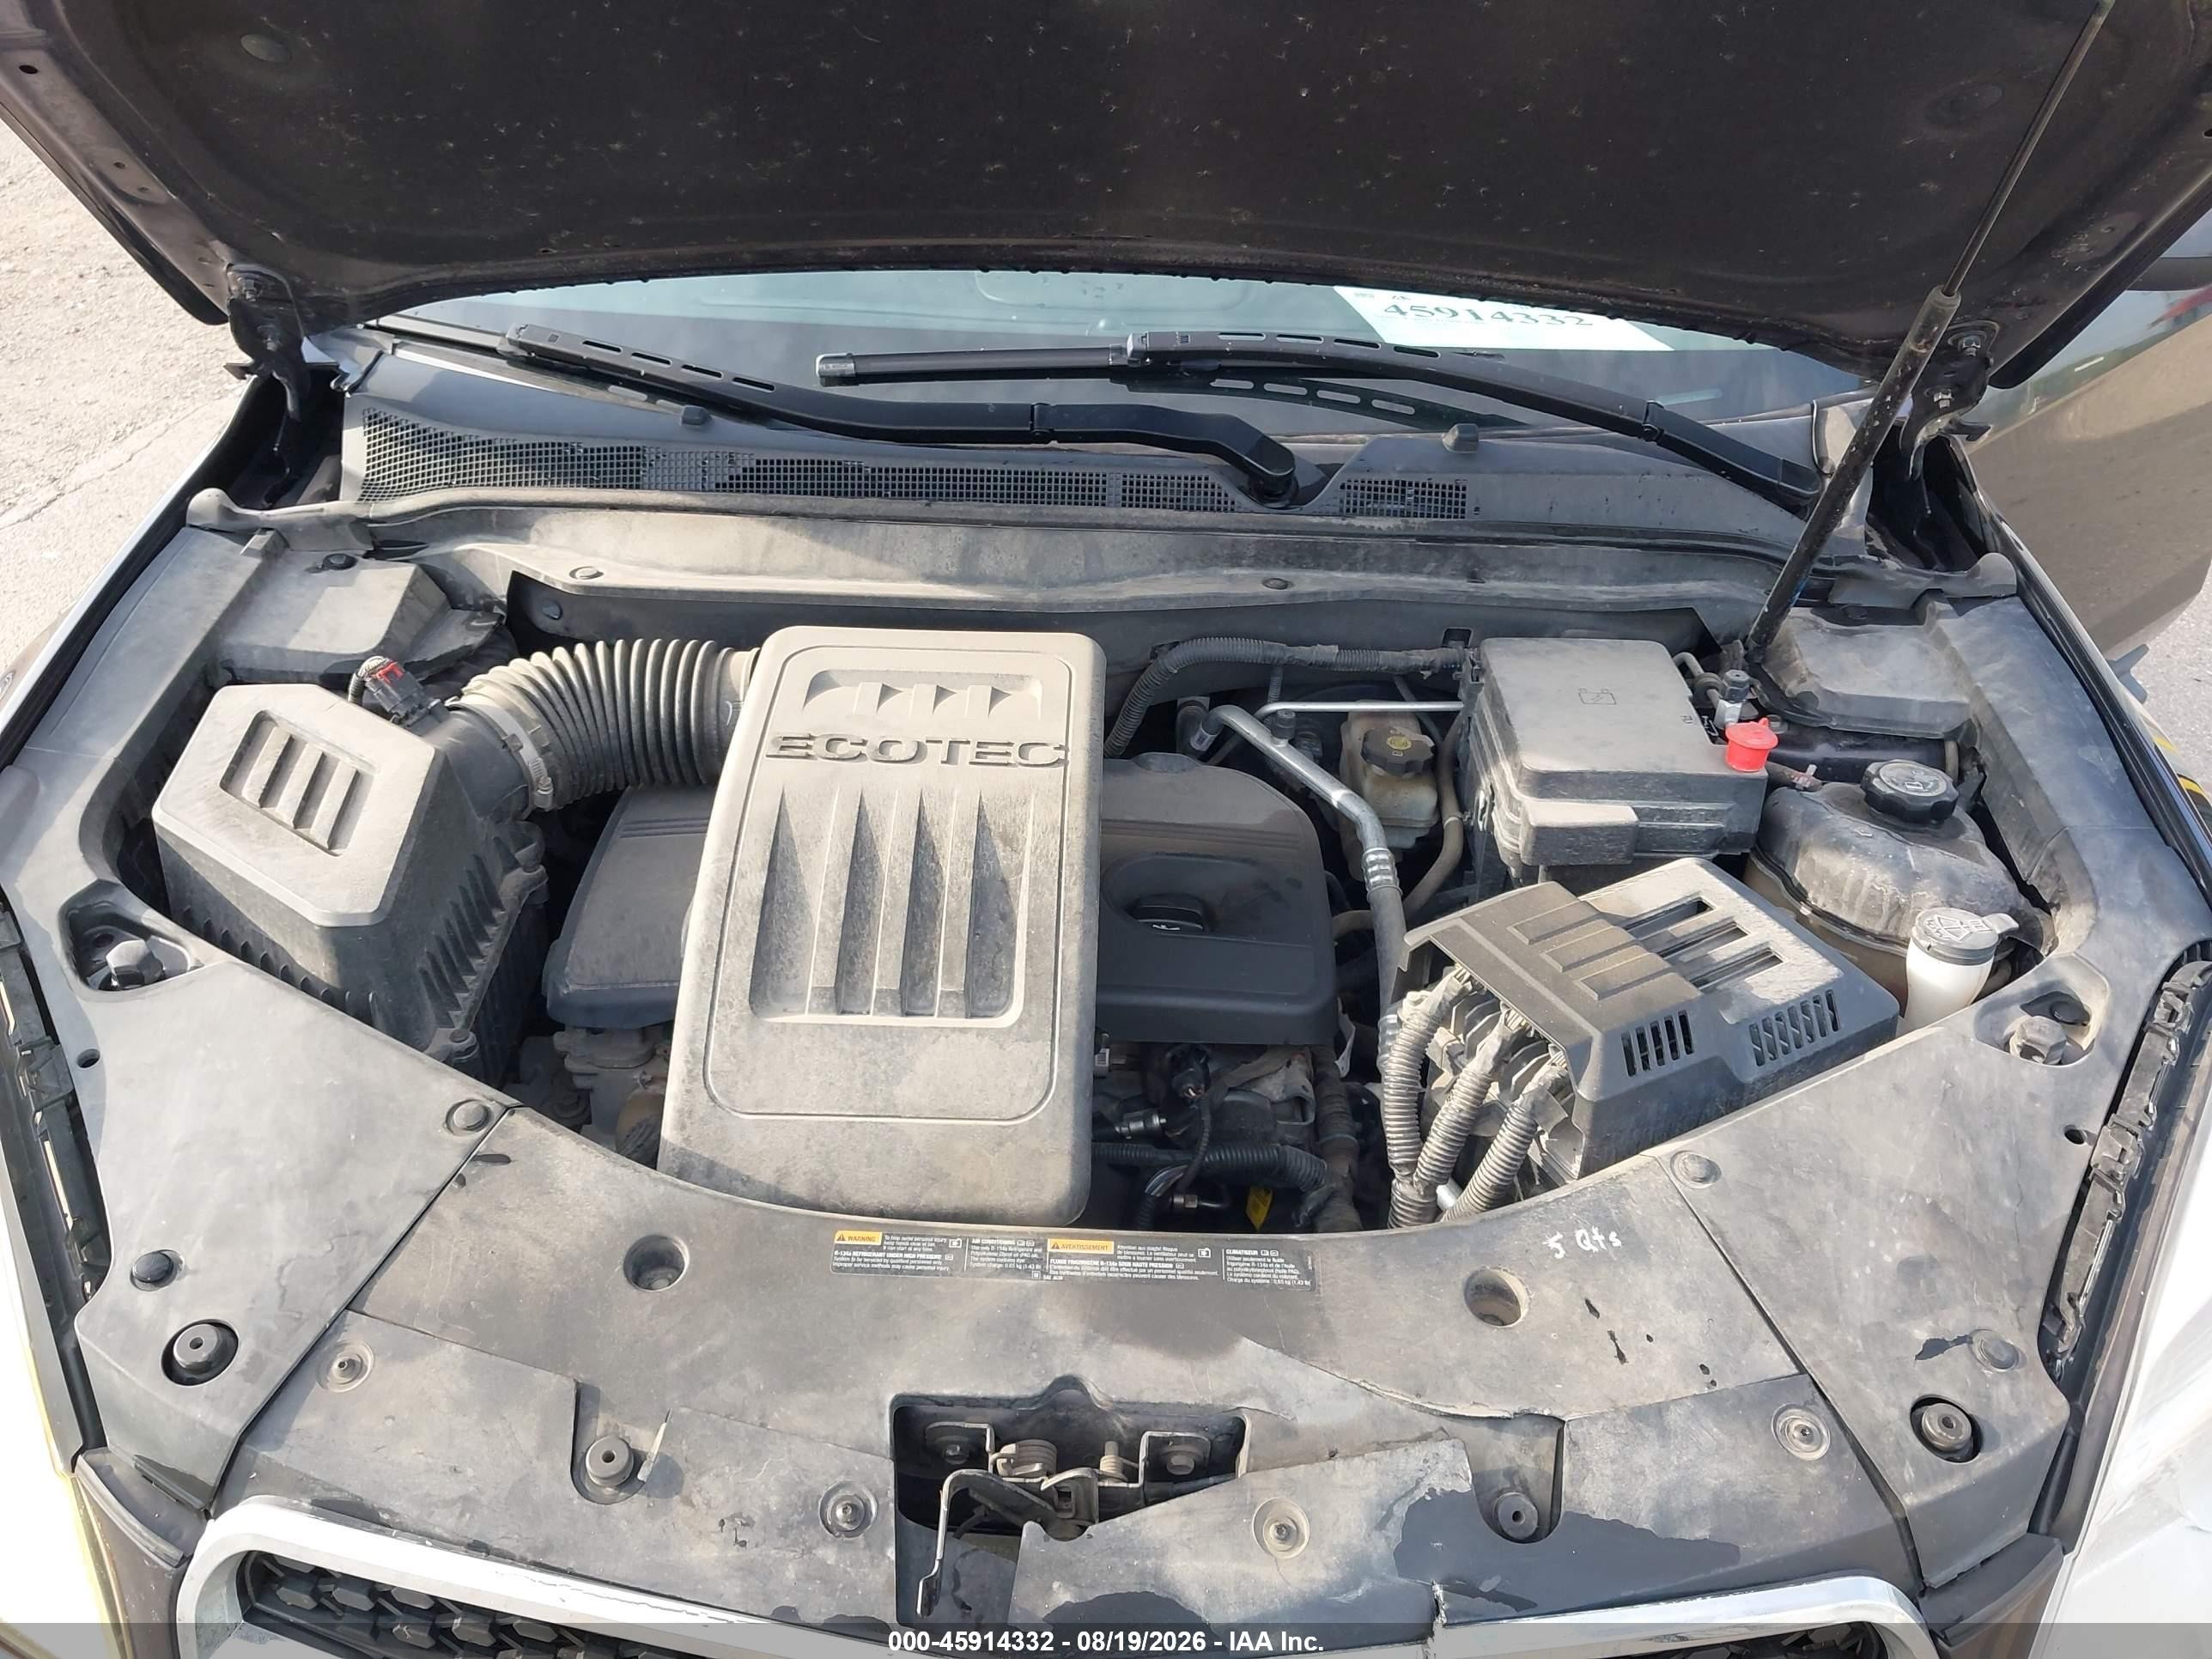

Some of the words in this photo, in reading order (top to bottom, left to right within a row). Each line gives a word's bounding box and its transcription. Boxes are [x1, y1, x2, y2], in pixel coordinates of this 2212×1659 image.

[1384, 303, 1593, 325] 45914332
[766, 732, 1068, 767] ECOTEC
[1542, 1231, 1565, 1259] 5
[1574, 1225, 1621, 1253] Qts
